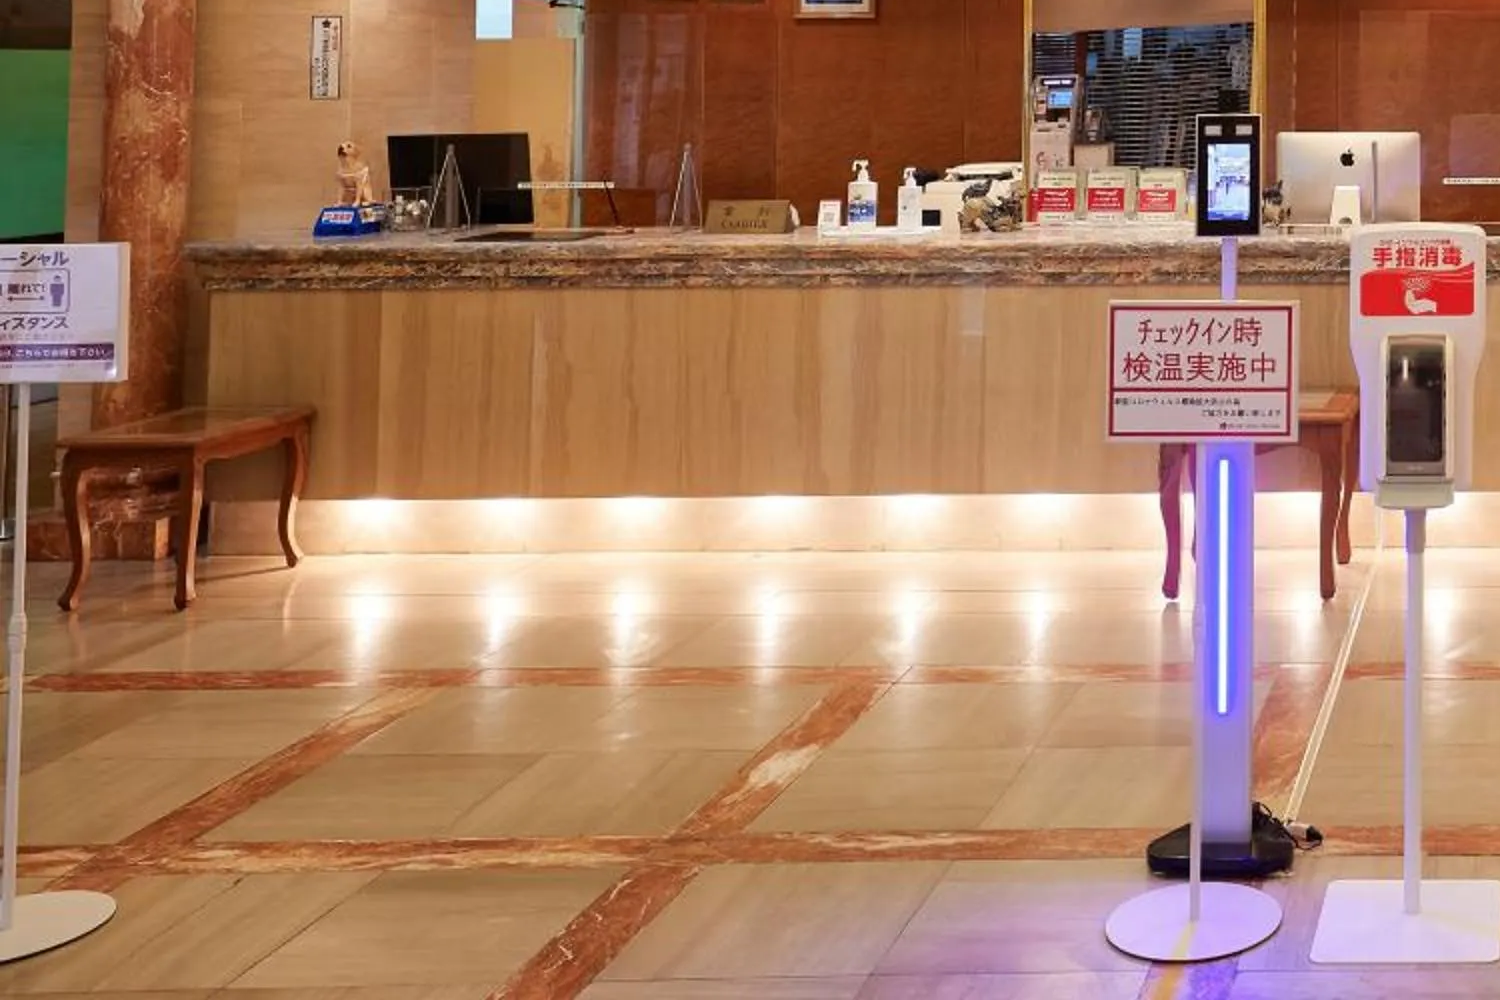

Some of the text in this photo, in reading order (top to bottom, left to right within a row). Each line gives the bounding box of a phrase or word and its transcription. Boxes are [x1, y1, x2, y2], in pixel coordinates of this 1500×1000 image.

[1372, 247, 1462, 267] 手指消毒
[1138, 316, 1263, 347] チェックイン時
[1122, 351, 1277, 383] 検温実施中
